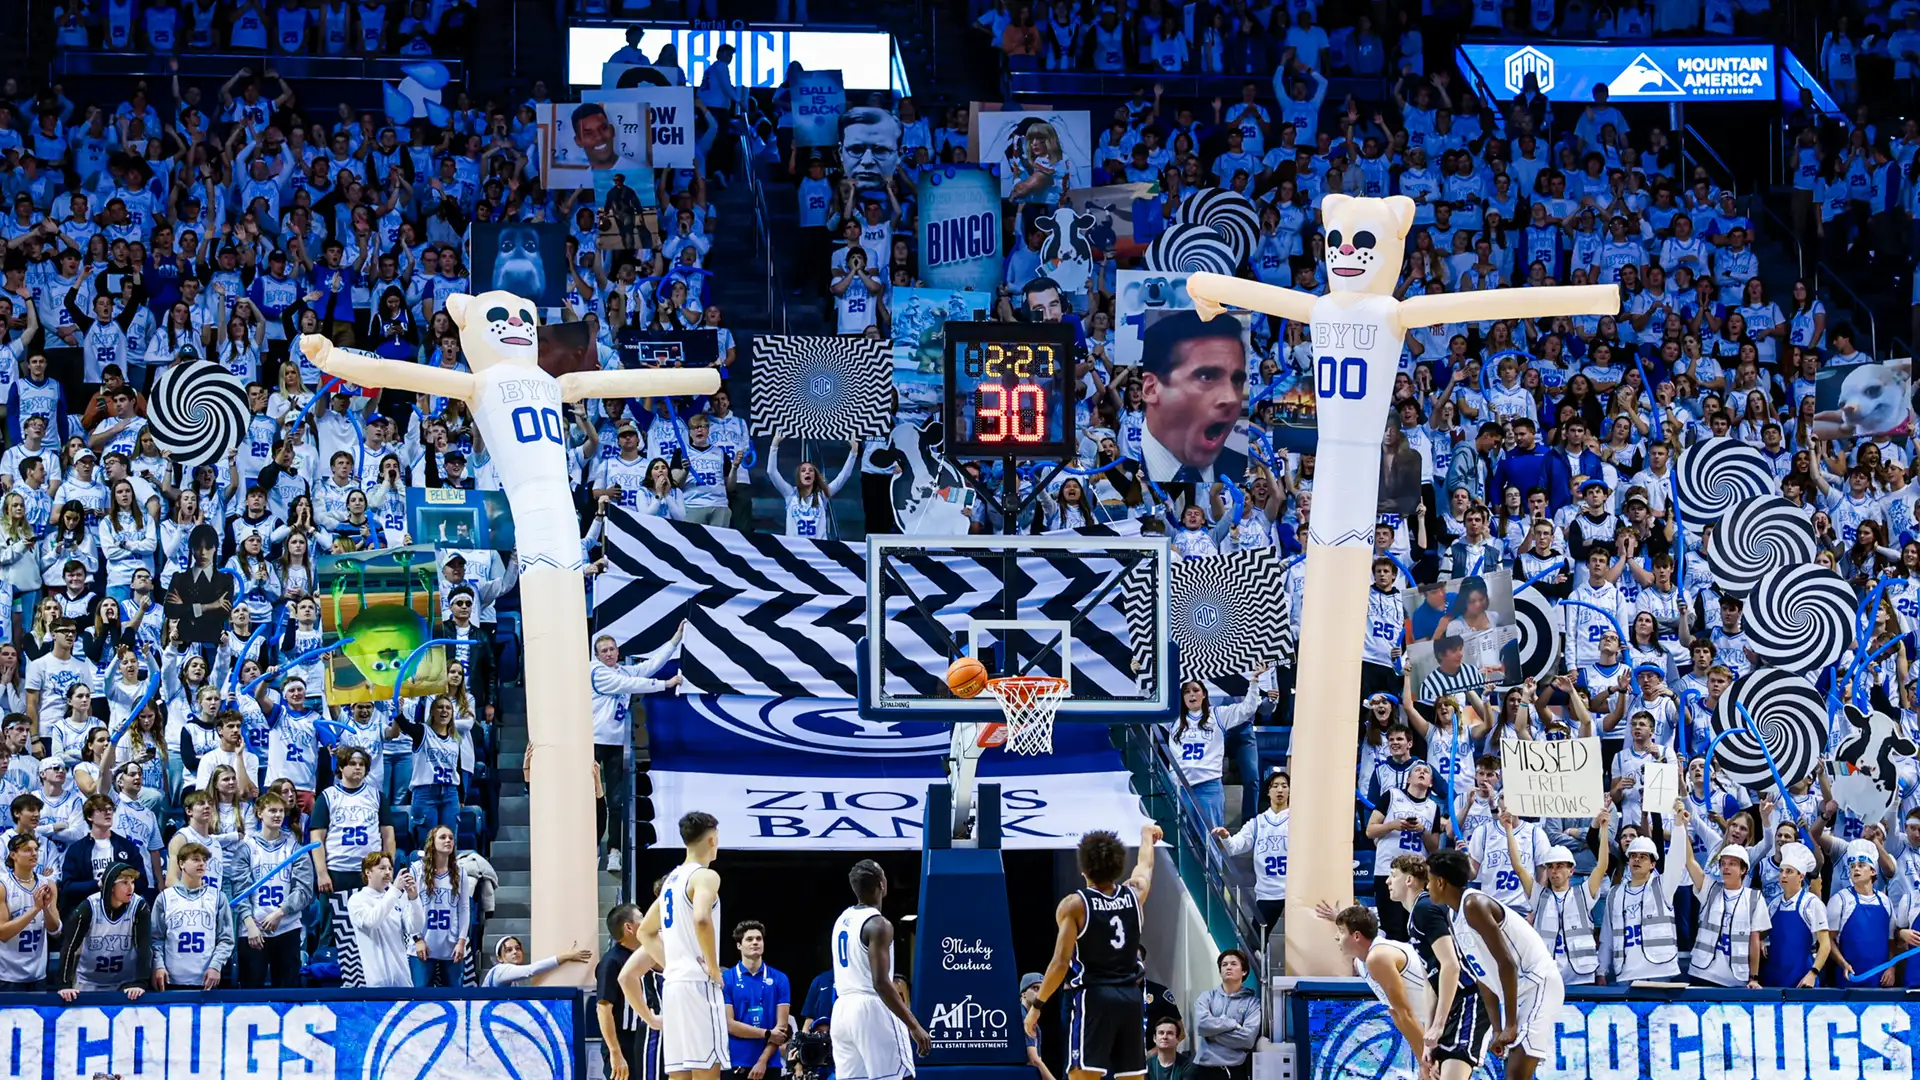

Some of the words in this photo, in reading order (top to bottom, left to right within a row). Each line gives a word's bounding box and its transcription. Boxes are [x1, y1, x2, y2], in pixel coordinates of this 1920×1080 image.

[694, 19, 726, 30] Portal
[1677, 57, 1767, 72] MOUNTAIN
[1683, 72, 1762, 87] AMERICA
[800, 86, 837, 95] BALL
[799, 105, 840, 115] BACK
[813, 96, 826, 105] IS
[1293, 117, 1308, 128] 25
[1241, 127, 1256, 138] 25
[1366, 181, 1380, 193] 25
[1851, 174, 1867, 186] 25
[810, 197, 825, 209] 25
[926, 211, 996, 267] BINGO
[1263, 256, 1279, 269] 25
[1536, 250, 1551, 263] 25
[848, 299, 866, 313] 25
[1315, 322, 1378, 350] BYU
[97, 348, 116, 362] 25
[985, 344, 1055, 378] 2:27
[231, 363, 248, 376] 25
[1317, 356, 1368, 400] 00
[499, 380, 560, 405] BYU
[977, 383, 1045, 443] 30
[511, 406, 564, 446] 00
[251, 441, 269, 457] 25
[429, 489, 465, 502] BELIEVE
[385, 513, 404, 531] 25
[797, 520, 816, 536] 25
[1174, 538, 1211, 554] BYU
[465, 560, 489, 578] YU
[1197, 605, 1217, 628] ROC
[1896, 597, 1920, 617] 25
[1372, 621, 1395, 641] 25
[880, 701, 910, 709] SPALDING
[250, 728, 270, 747] 25
[1182, 743, 1205, 761] 25
[1500, 738, 1589, 773] MISSED
[433, 766, 453, 784] 25
[1528, 775, 1571, 794] FREE
[1649, 768, 1674, 806] 4
[745, 788, 1048, 811] ZIOS
[1513, 793, 1591, 815] THROWS
[332, 805, 380, 824] BYU
[1393, 810, 1433, 832] BU
[118, 812, 152, 838] BYU
[1843, 816, 1865, 839] 25
[342, 826, 369, 846] 25
[1399, 831, 1423, 853] 25
[1264, 856, 1287, 876] 25
[1487, 850, 1531, 869] BYU
[1496, 870, 1520, 891] 25
[258, 885, 285, 907] 25
[663, 888, 674, 929] 3
[169, 909, 215, 931] BYU
[426, 909, 451, 930] 25
[19, 930, 41, 953] 25
[178, 931, 205, 953] 25
[1109, 915, 1126, 950] 3
[88, 934, 133, 952] BYU
[837, 930, 849, 968] 0
[941, 936, 993, 960] Minky
[95, 955, 125, 973] 25
[942, 954, 993, 971] Couture
[0, 1007, 44, 1080] O
[55, 1004, 337, 1080] COUGS
[929, 1028, 1008, 1040] Capital
[1536, 1004, 1638, 1080] GO
[1647, 1003, 1914, 1080] COUGS
